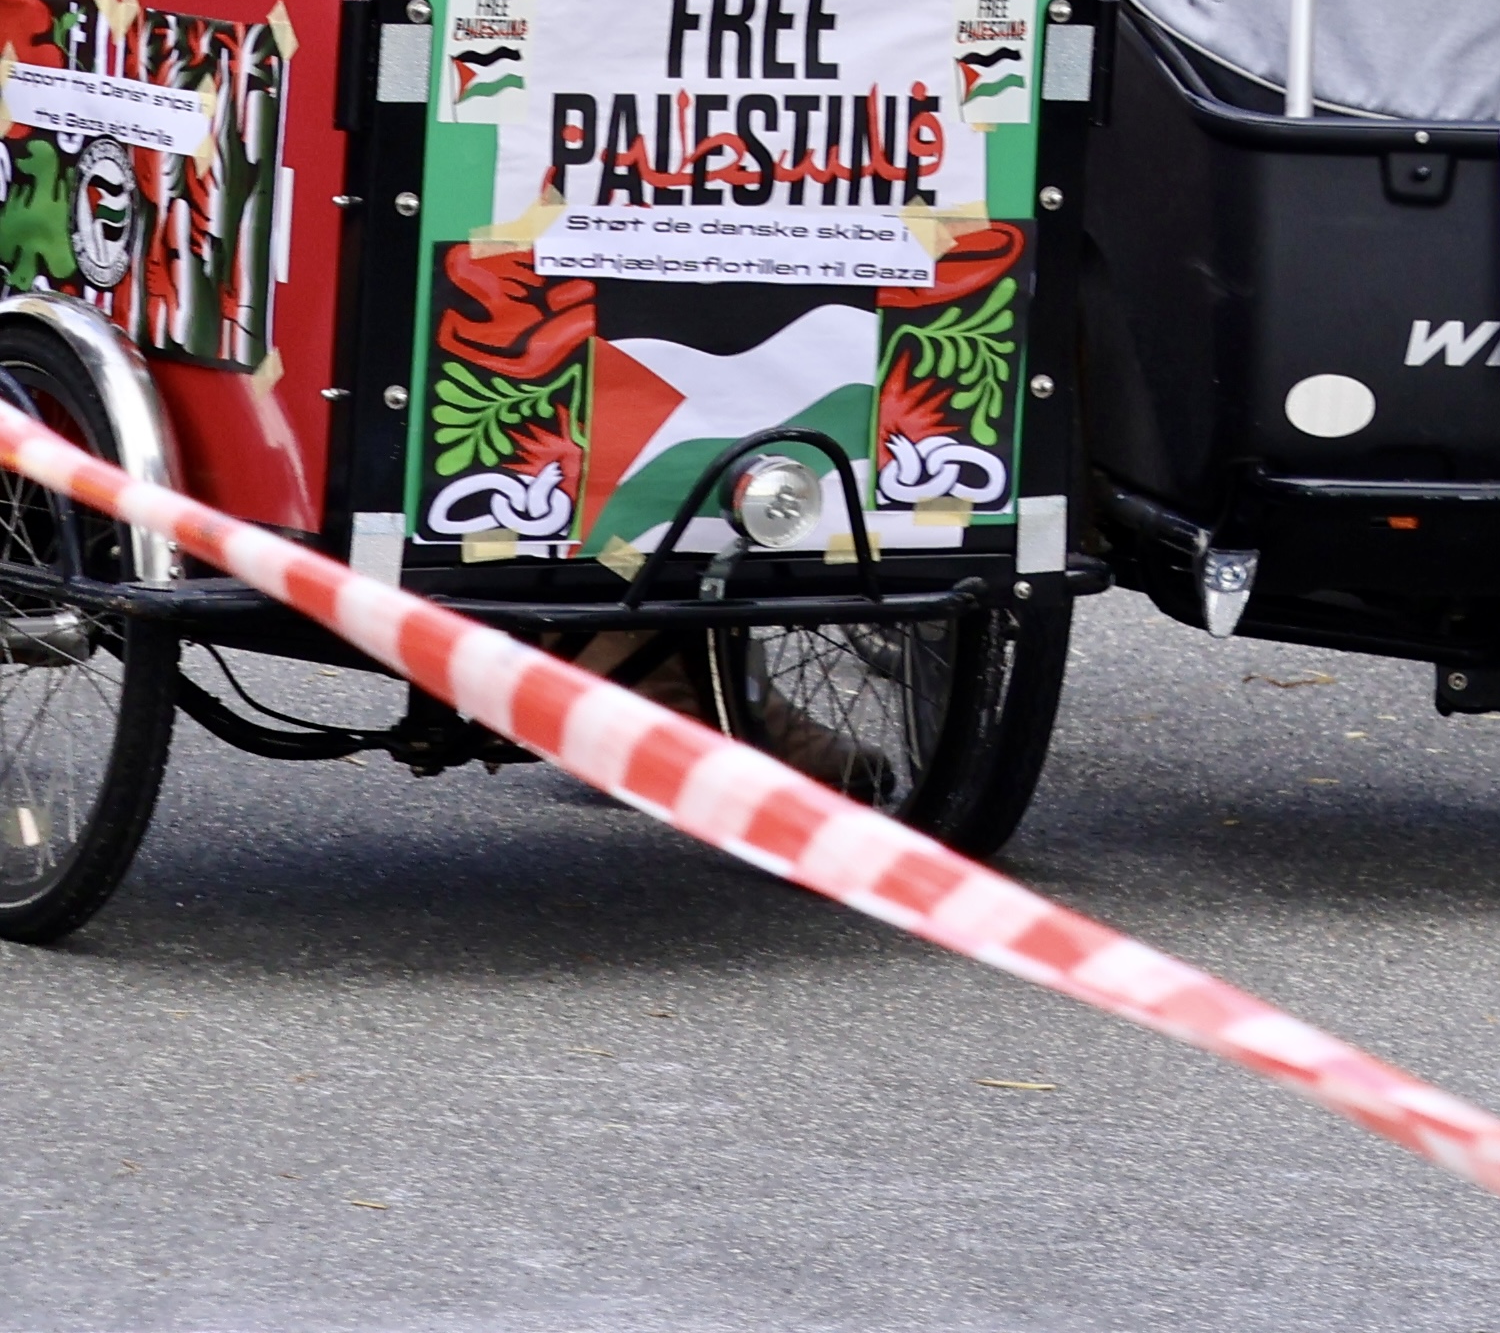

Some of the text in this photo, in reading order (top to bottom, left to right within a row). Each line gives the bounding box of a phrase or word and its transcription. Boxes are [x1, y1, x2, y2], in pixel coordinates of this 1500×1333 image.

[65, 112, 105, 131] Gaza
[552, 92, 942, 207] PALESTINE
[565, 214, 909, 243] Støt de danske skibe i
[539, 253, 928, 282] nødhjælpsflotillen til Gaza
